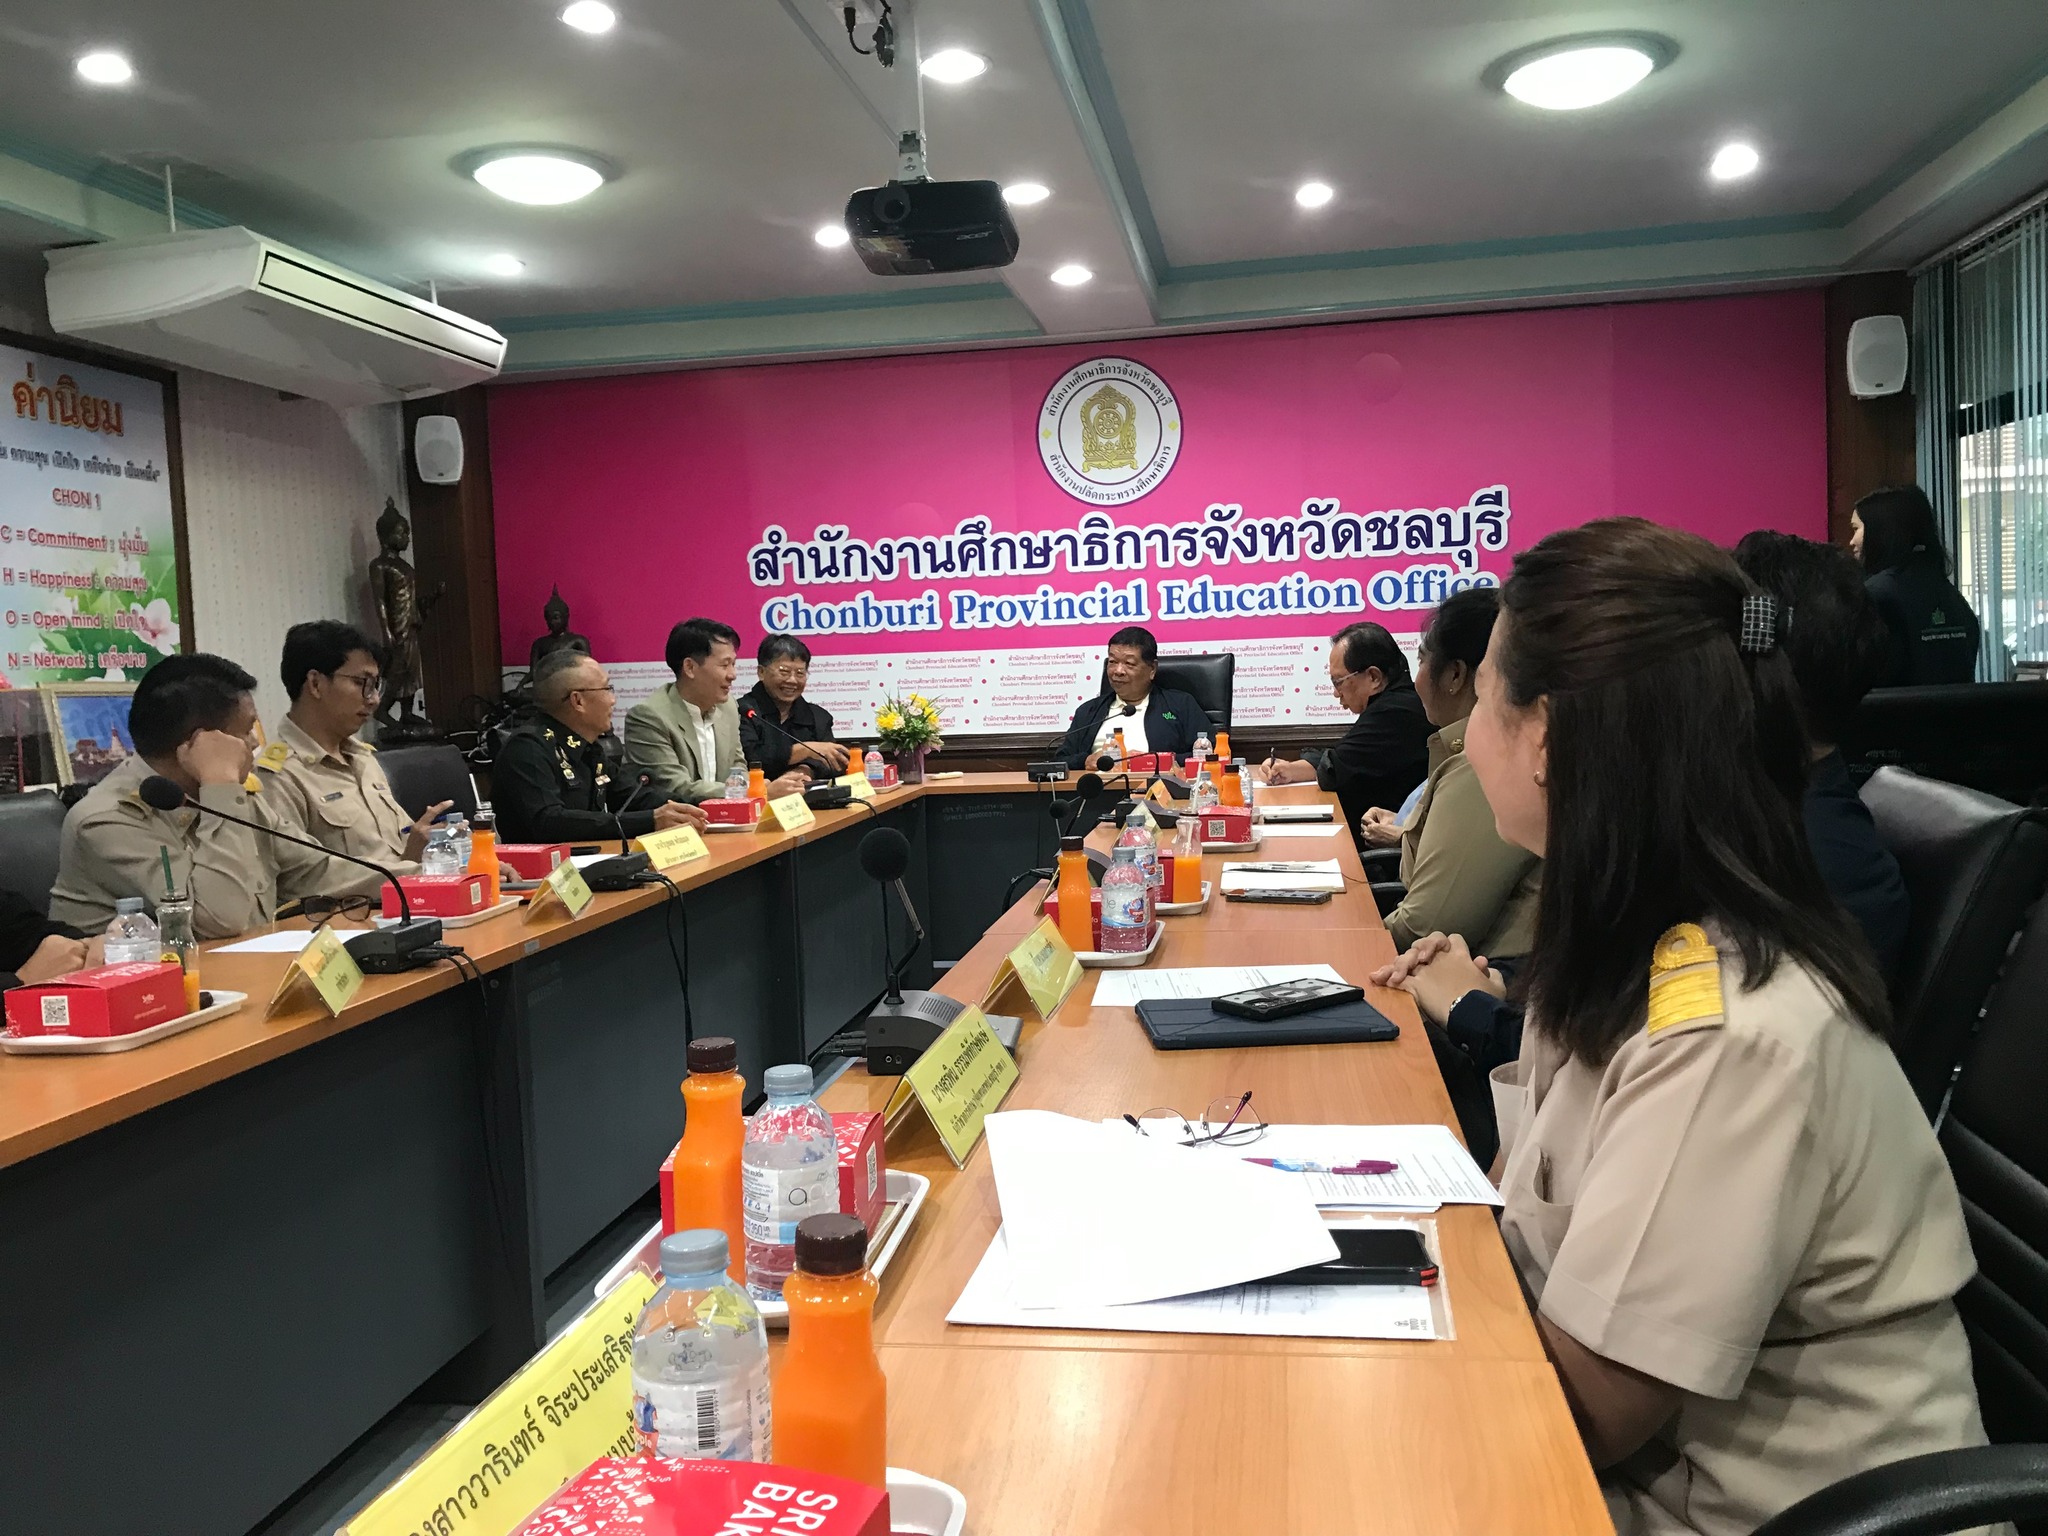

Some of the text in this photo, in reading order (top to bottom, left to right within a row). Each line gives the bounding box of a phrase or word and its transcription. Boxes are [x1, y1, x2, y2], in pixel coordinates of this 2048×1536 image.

[13, 361, 124, 436] ค่านิยม
[52, 488, 90, 507] CHON
[0, 525, 11, 542] C
[28, 528, 107, 551] Commitment
[752, 491, 1504, 581] สำนักงานศึกษาธิการจังหวัดชลบุรี
[3, 567, 14, 584] H
[30, 569, 92, 592] Happiness
[766, 591, 937, 631] Chonburi
[954, 580, 1146, 624] Provincial
[1162, 576, 1358, 616] Education
[6, 610, 17, 627] O
[33, 610, 67, 629] Open
[71, 612, 101, 628] mind
[8, 653, 18, 668] N
[34, 652, 86, 669] Network
[408, 1404, 545, 1536] งสาววารินทร์
